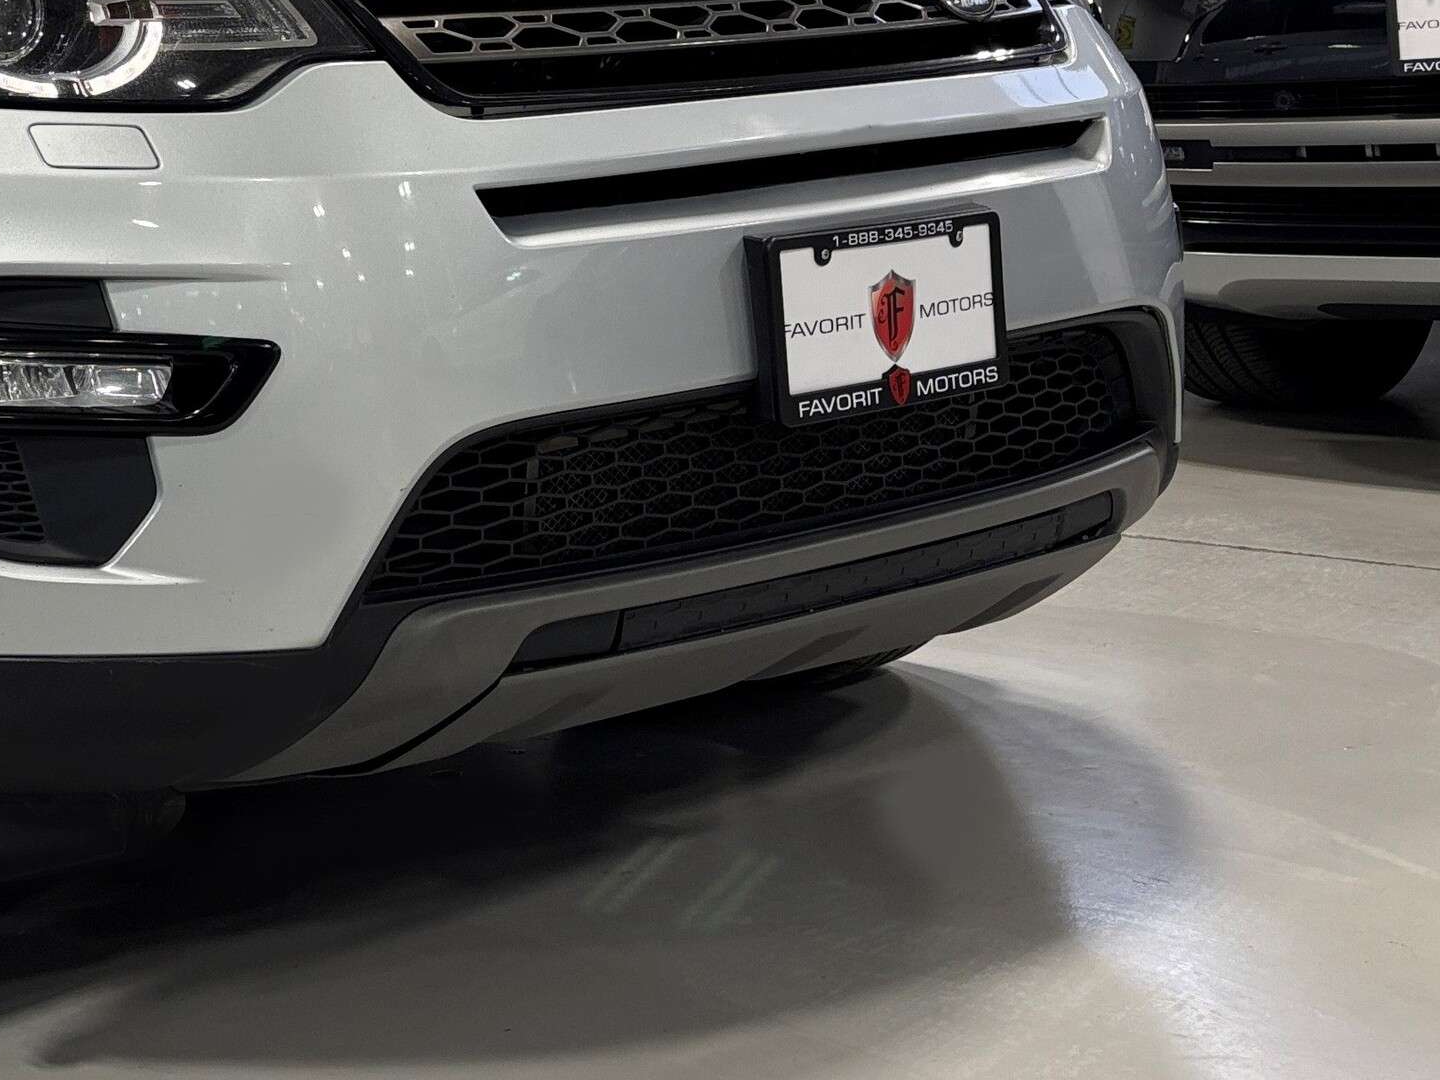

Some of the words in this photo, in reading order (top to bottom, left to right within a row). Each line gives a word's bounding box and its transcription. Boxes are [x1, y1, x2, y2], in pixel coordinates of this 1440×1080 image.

[832, 220, 954, 248] 1-888-345-9345
[783, 313, 867, 339] FAVORIT
[919, 291, 994, 319] MOTORS
[799, 387, 883, 418] FAVORIT
[916, 365, 999, 397] MOTORS
